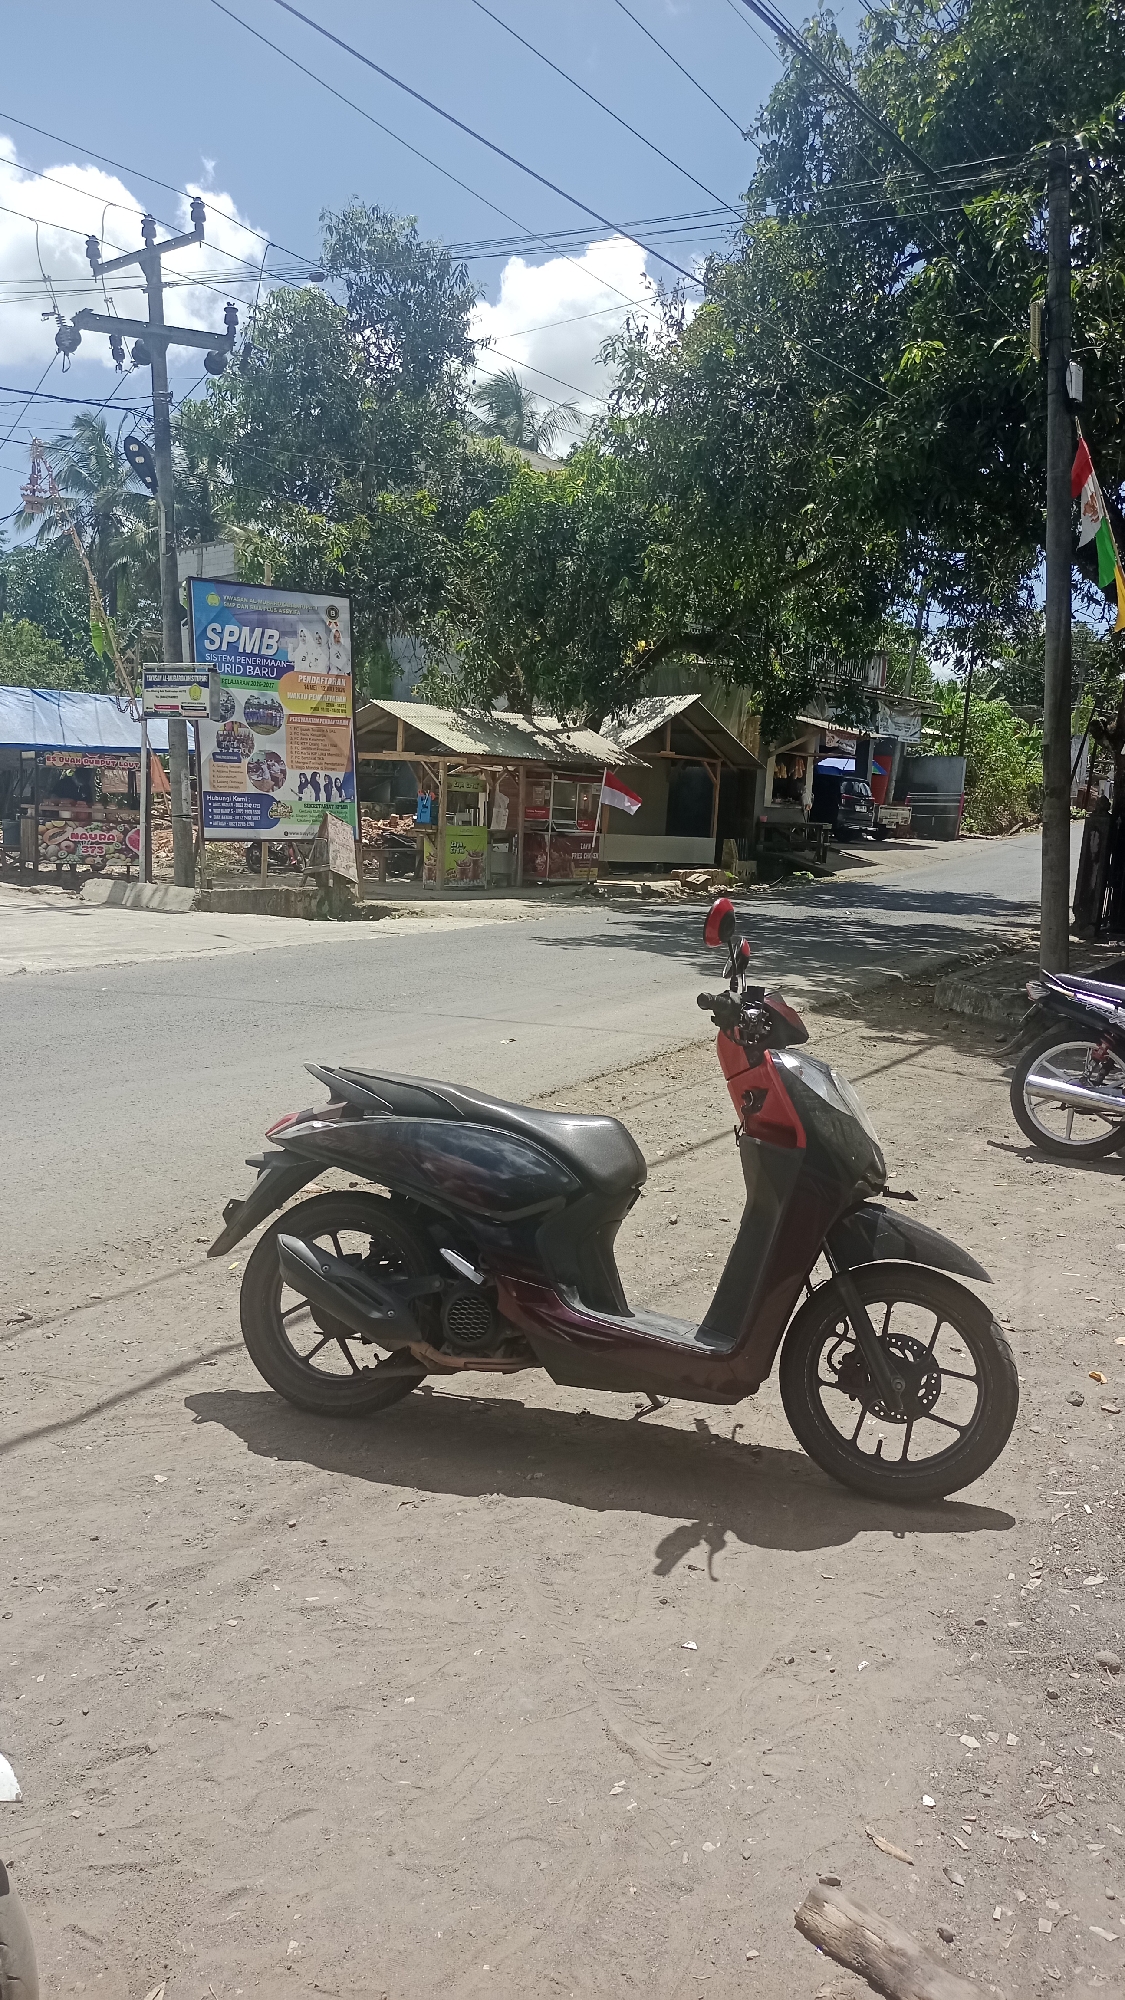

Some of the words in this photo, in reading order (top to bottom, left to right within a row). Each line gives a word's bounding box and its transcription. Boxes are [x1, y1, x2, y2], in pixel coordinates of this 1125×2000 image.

[204, 623, 280, 656] SPMB
[205, 653, 235, 662] SISTEM
[236, 655, 287, 668] PENERIMAAN
[216, 663, 243, 674] URID
[246, 665, 277, 678] BARU
[221, 678, 250, 687] PELAJARAN
[298, 675, 346, 686] PENDAFTARAN
[118, 760, 140, 768] LAUT
[207, 795, 232, 803] Hubungi
[69, 832, 117, 842] NAURA
[81, 845, 105, 855] 373
